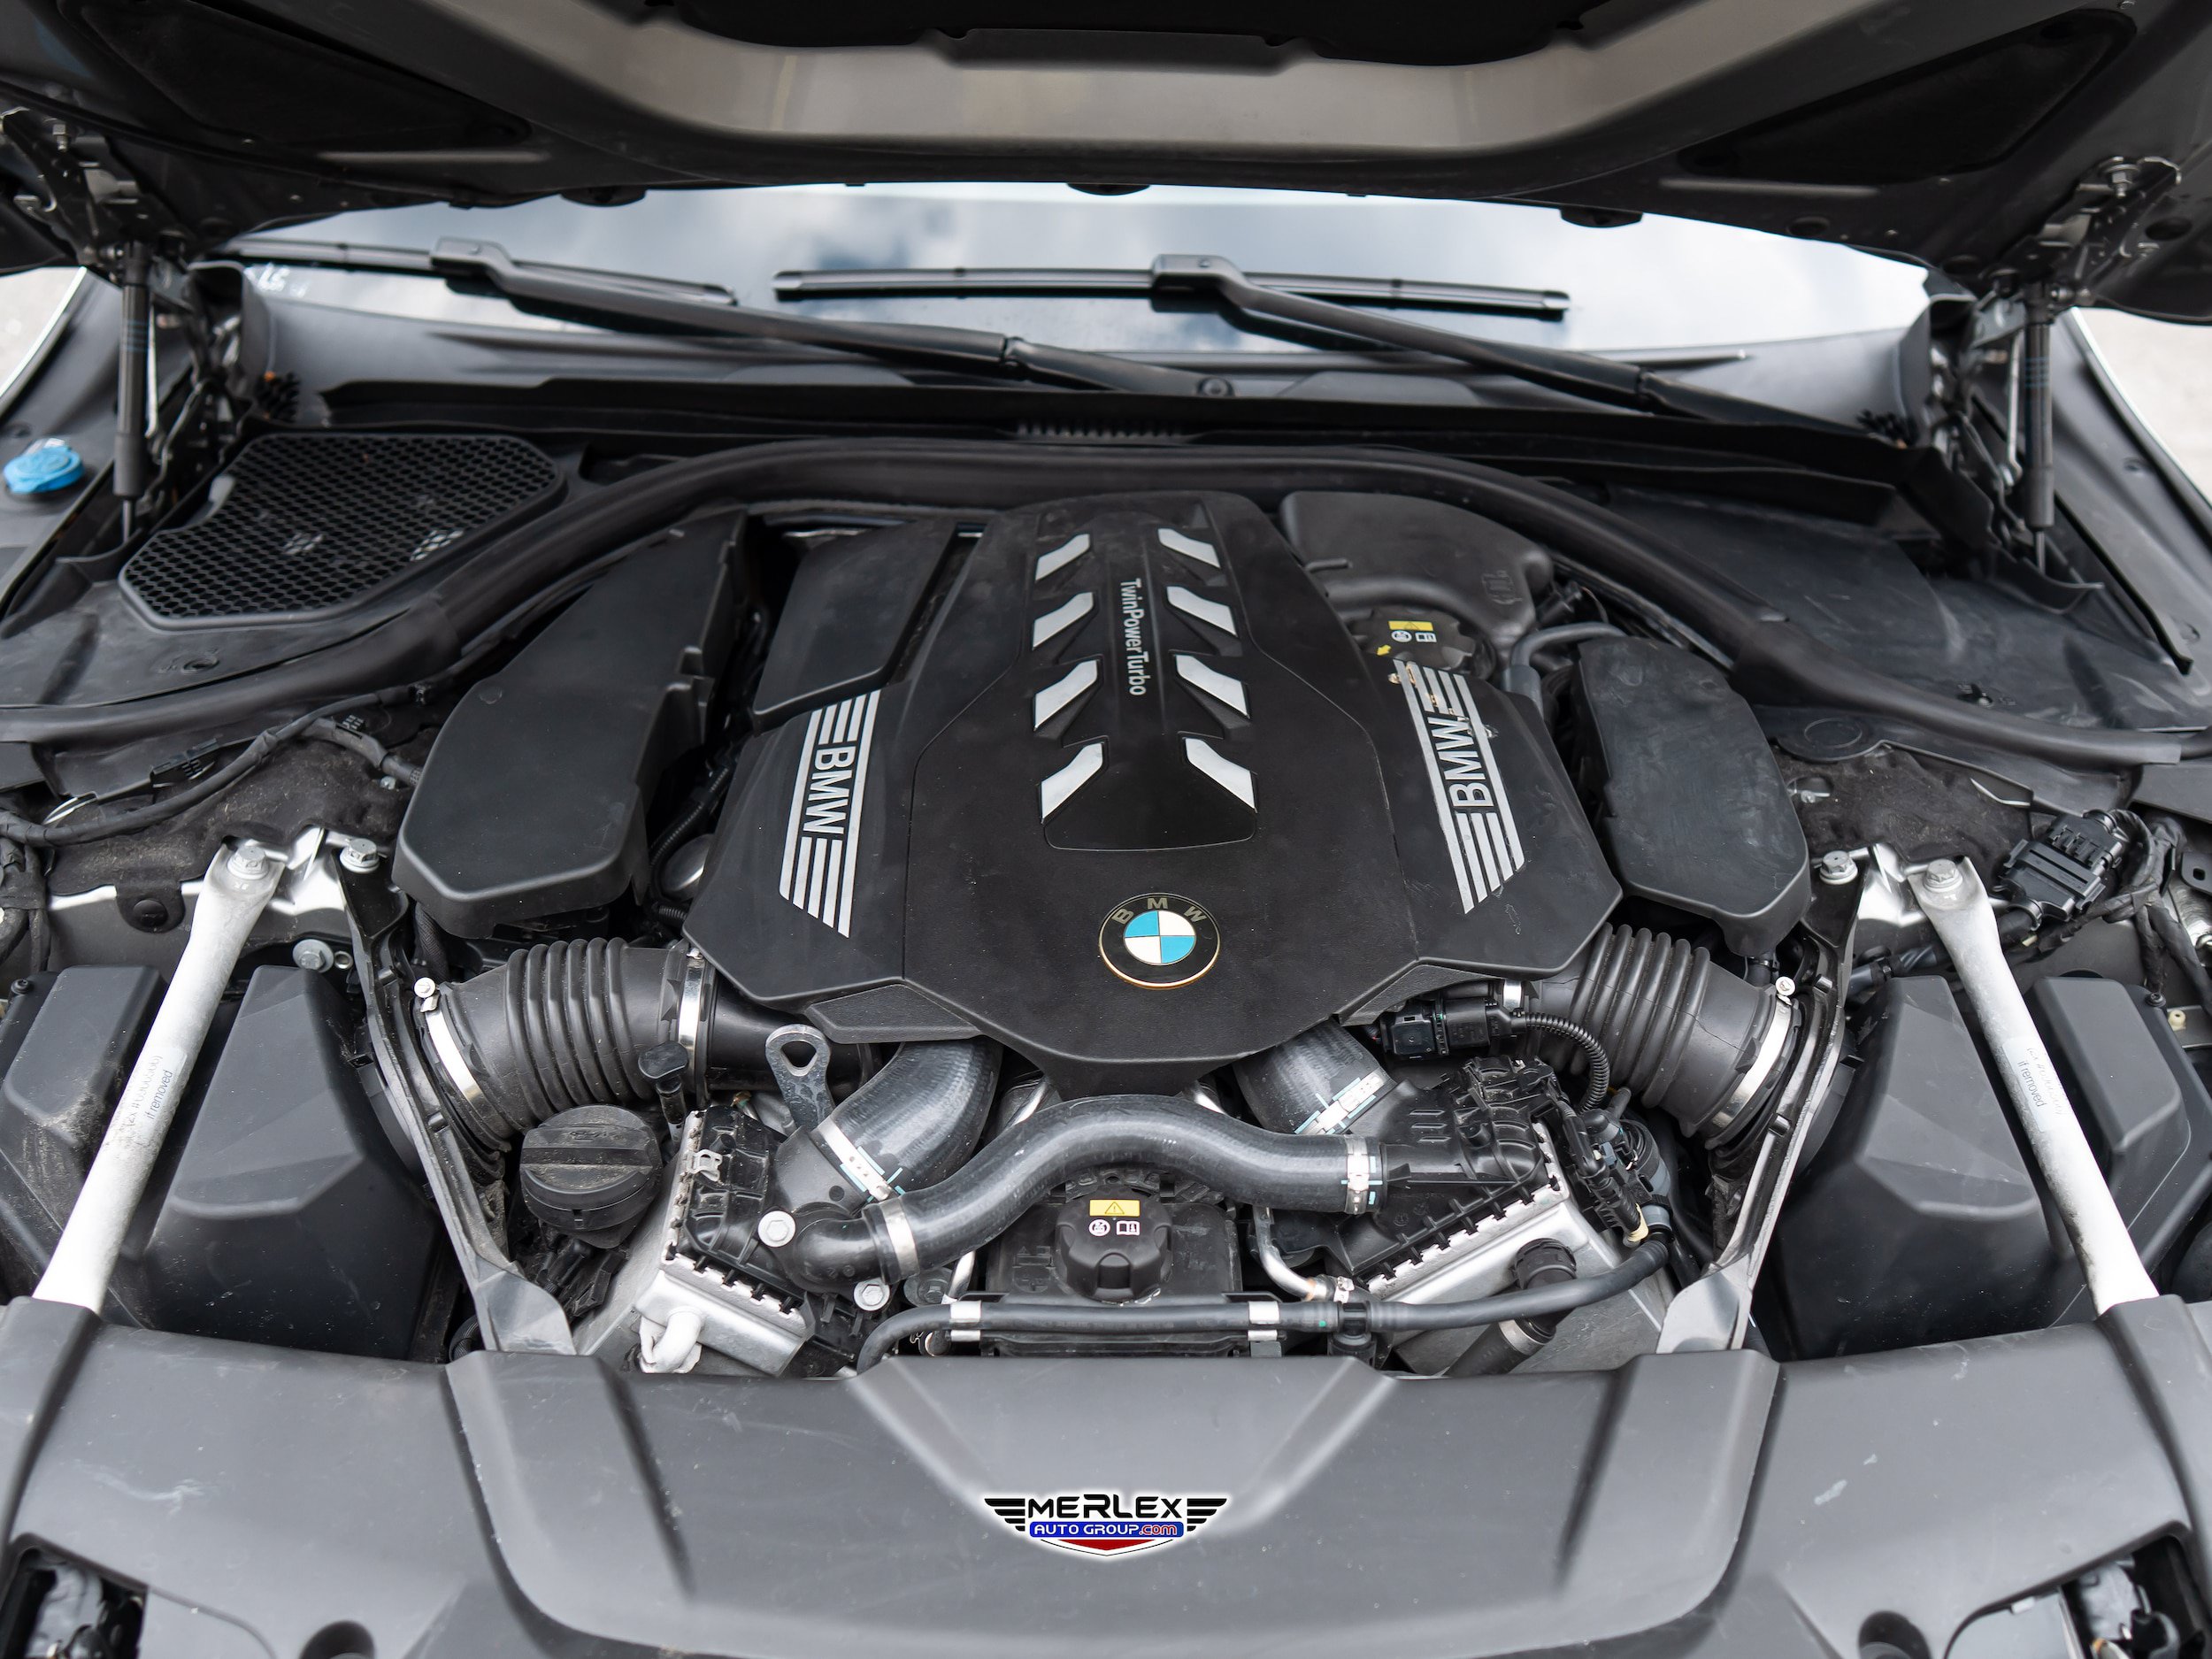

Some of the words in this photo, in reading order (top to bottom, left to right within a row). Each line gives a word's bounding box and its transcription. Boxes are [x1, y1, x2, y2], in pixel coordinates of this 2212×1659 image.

[1120, 578, 1144, 653] TwinPower
[1126, 651, 1151, 695] Turbo
[1427, 717, 1494, 807] BMW
[803, 746, 856, 834] BMW
[1111, 897, 1207, 925] BMW
[150, 1069, 173, 1112] removed
[2021, 1067, 2047, 1107] removed
